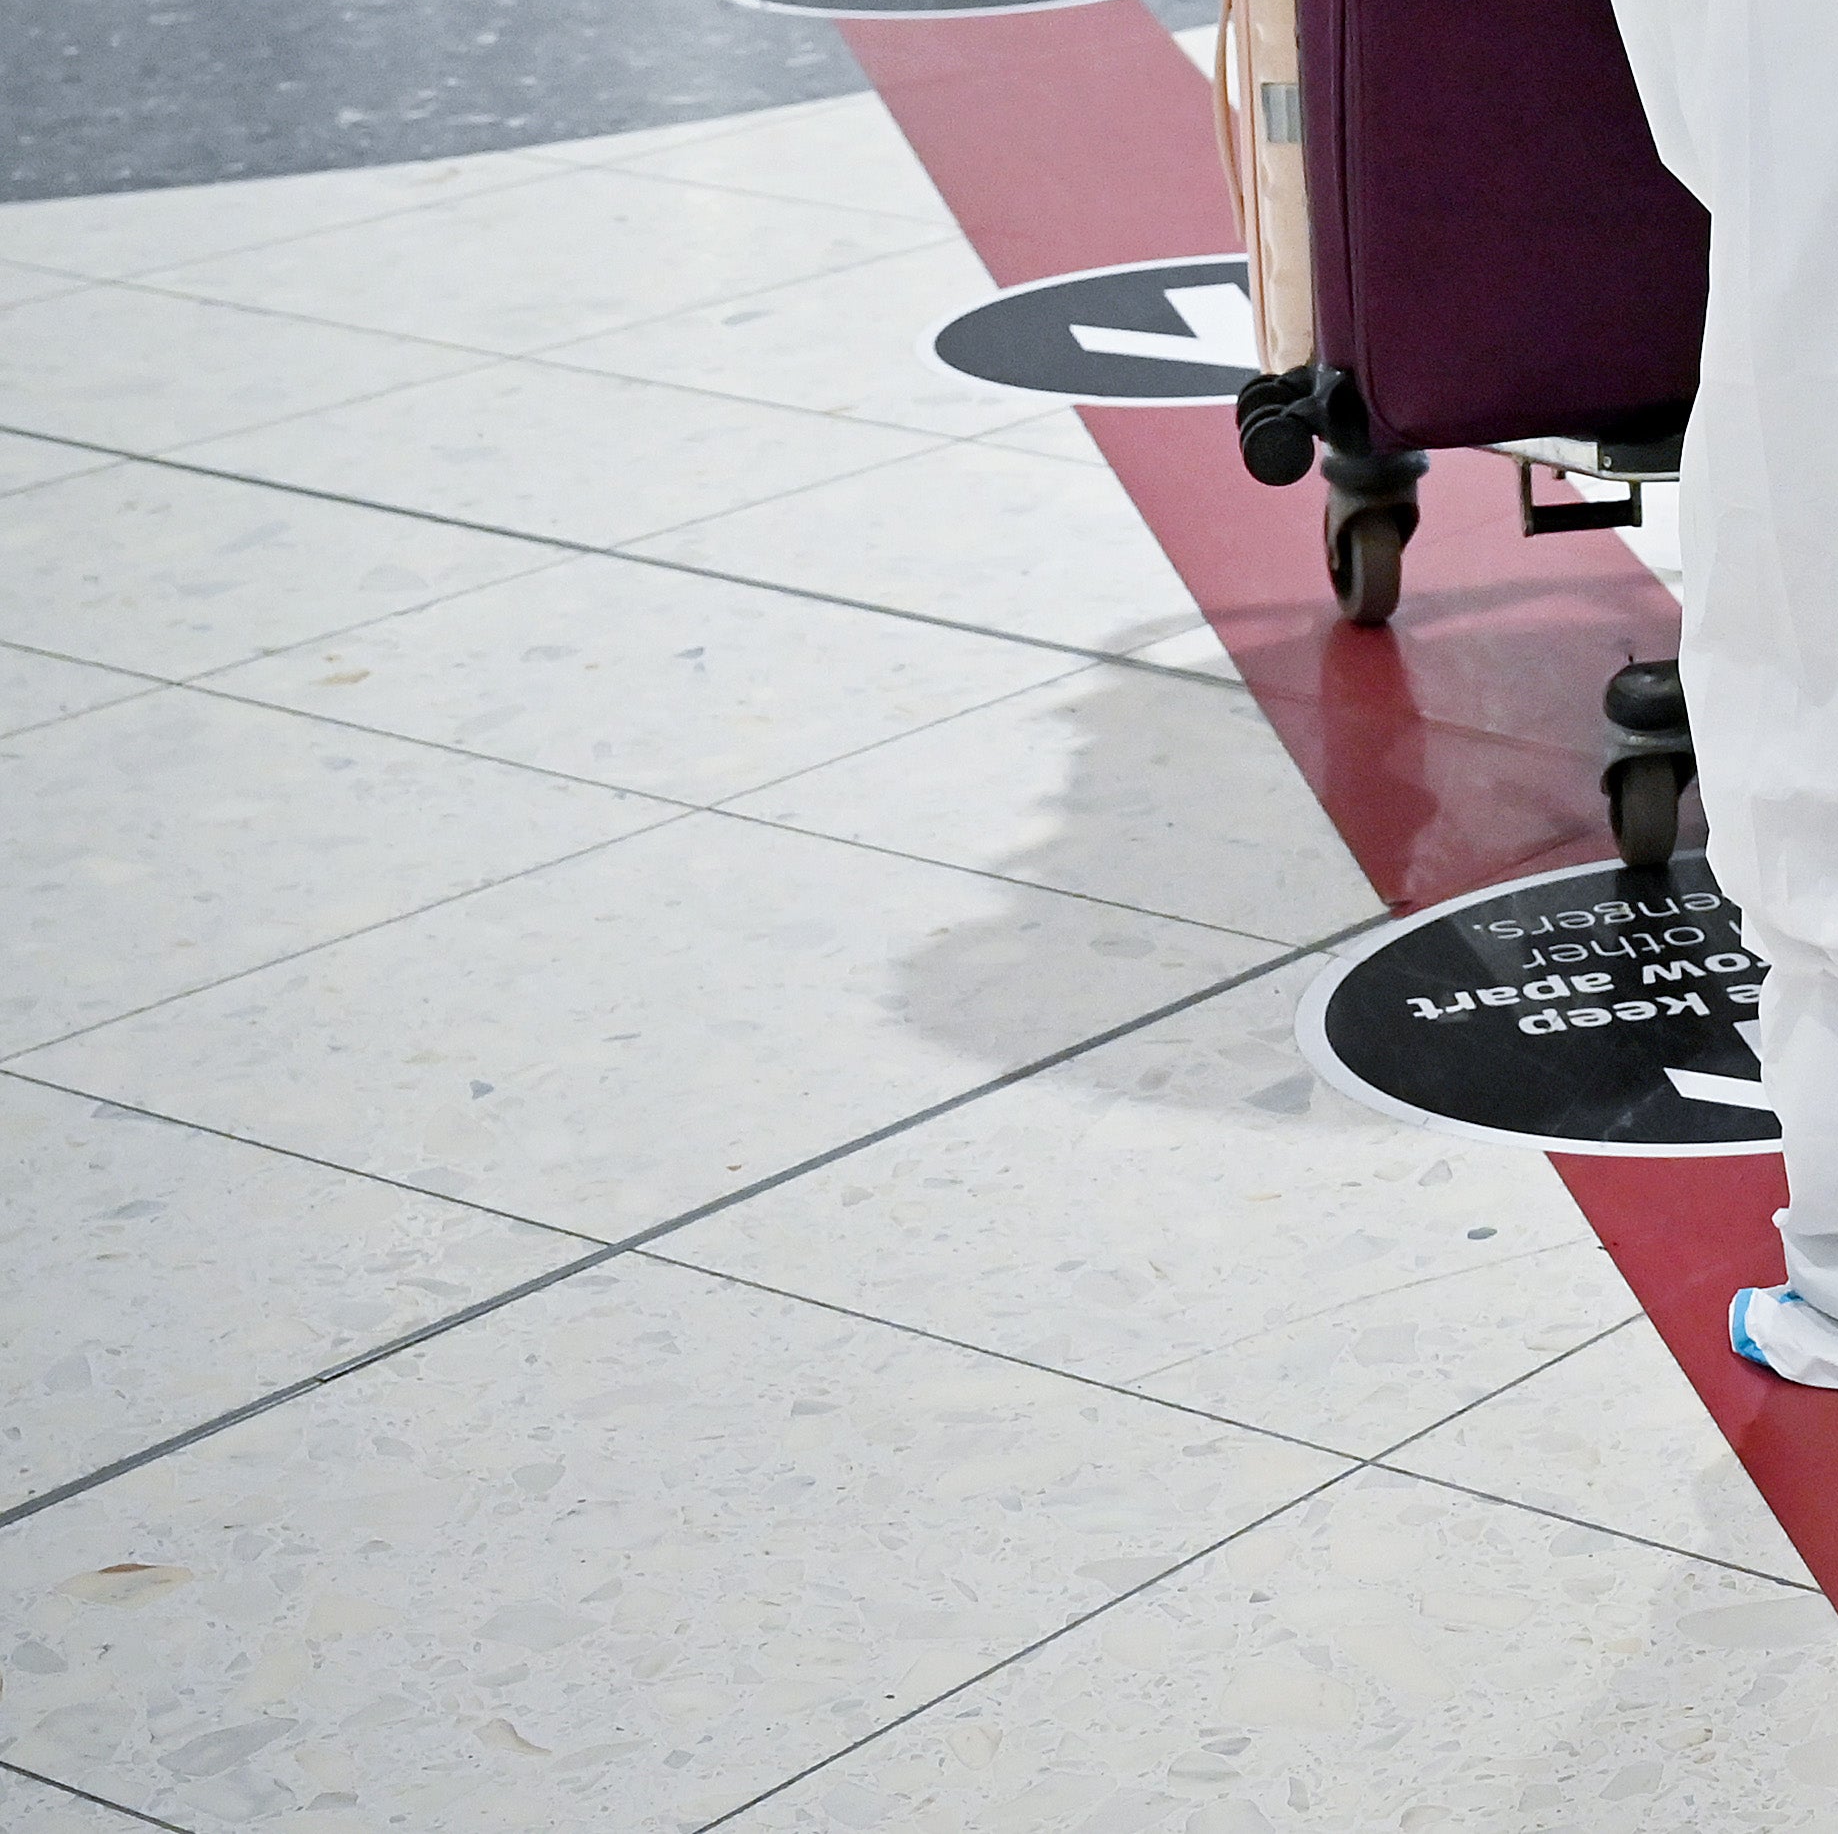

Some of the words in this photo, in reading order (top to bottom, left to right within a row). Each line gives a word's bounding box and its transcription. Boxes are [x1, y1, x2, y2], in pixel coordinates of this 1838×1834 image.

[1473, 891, 1723, 941] engers.
[1522, 926, 1706, 970] other
[1405, 971, 1615, 1020] apart
[1517, 991, 1710, 1036] keep
